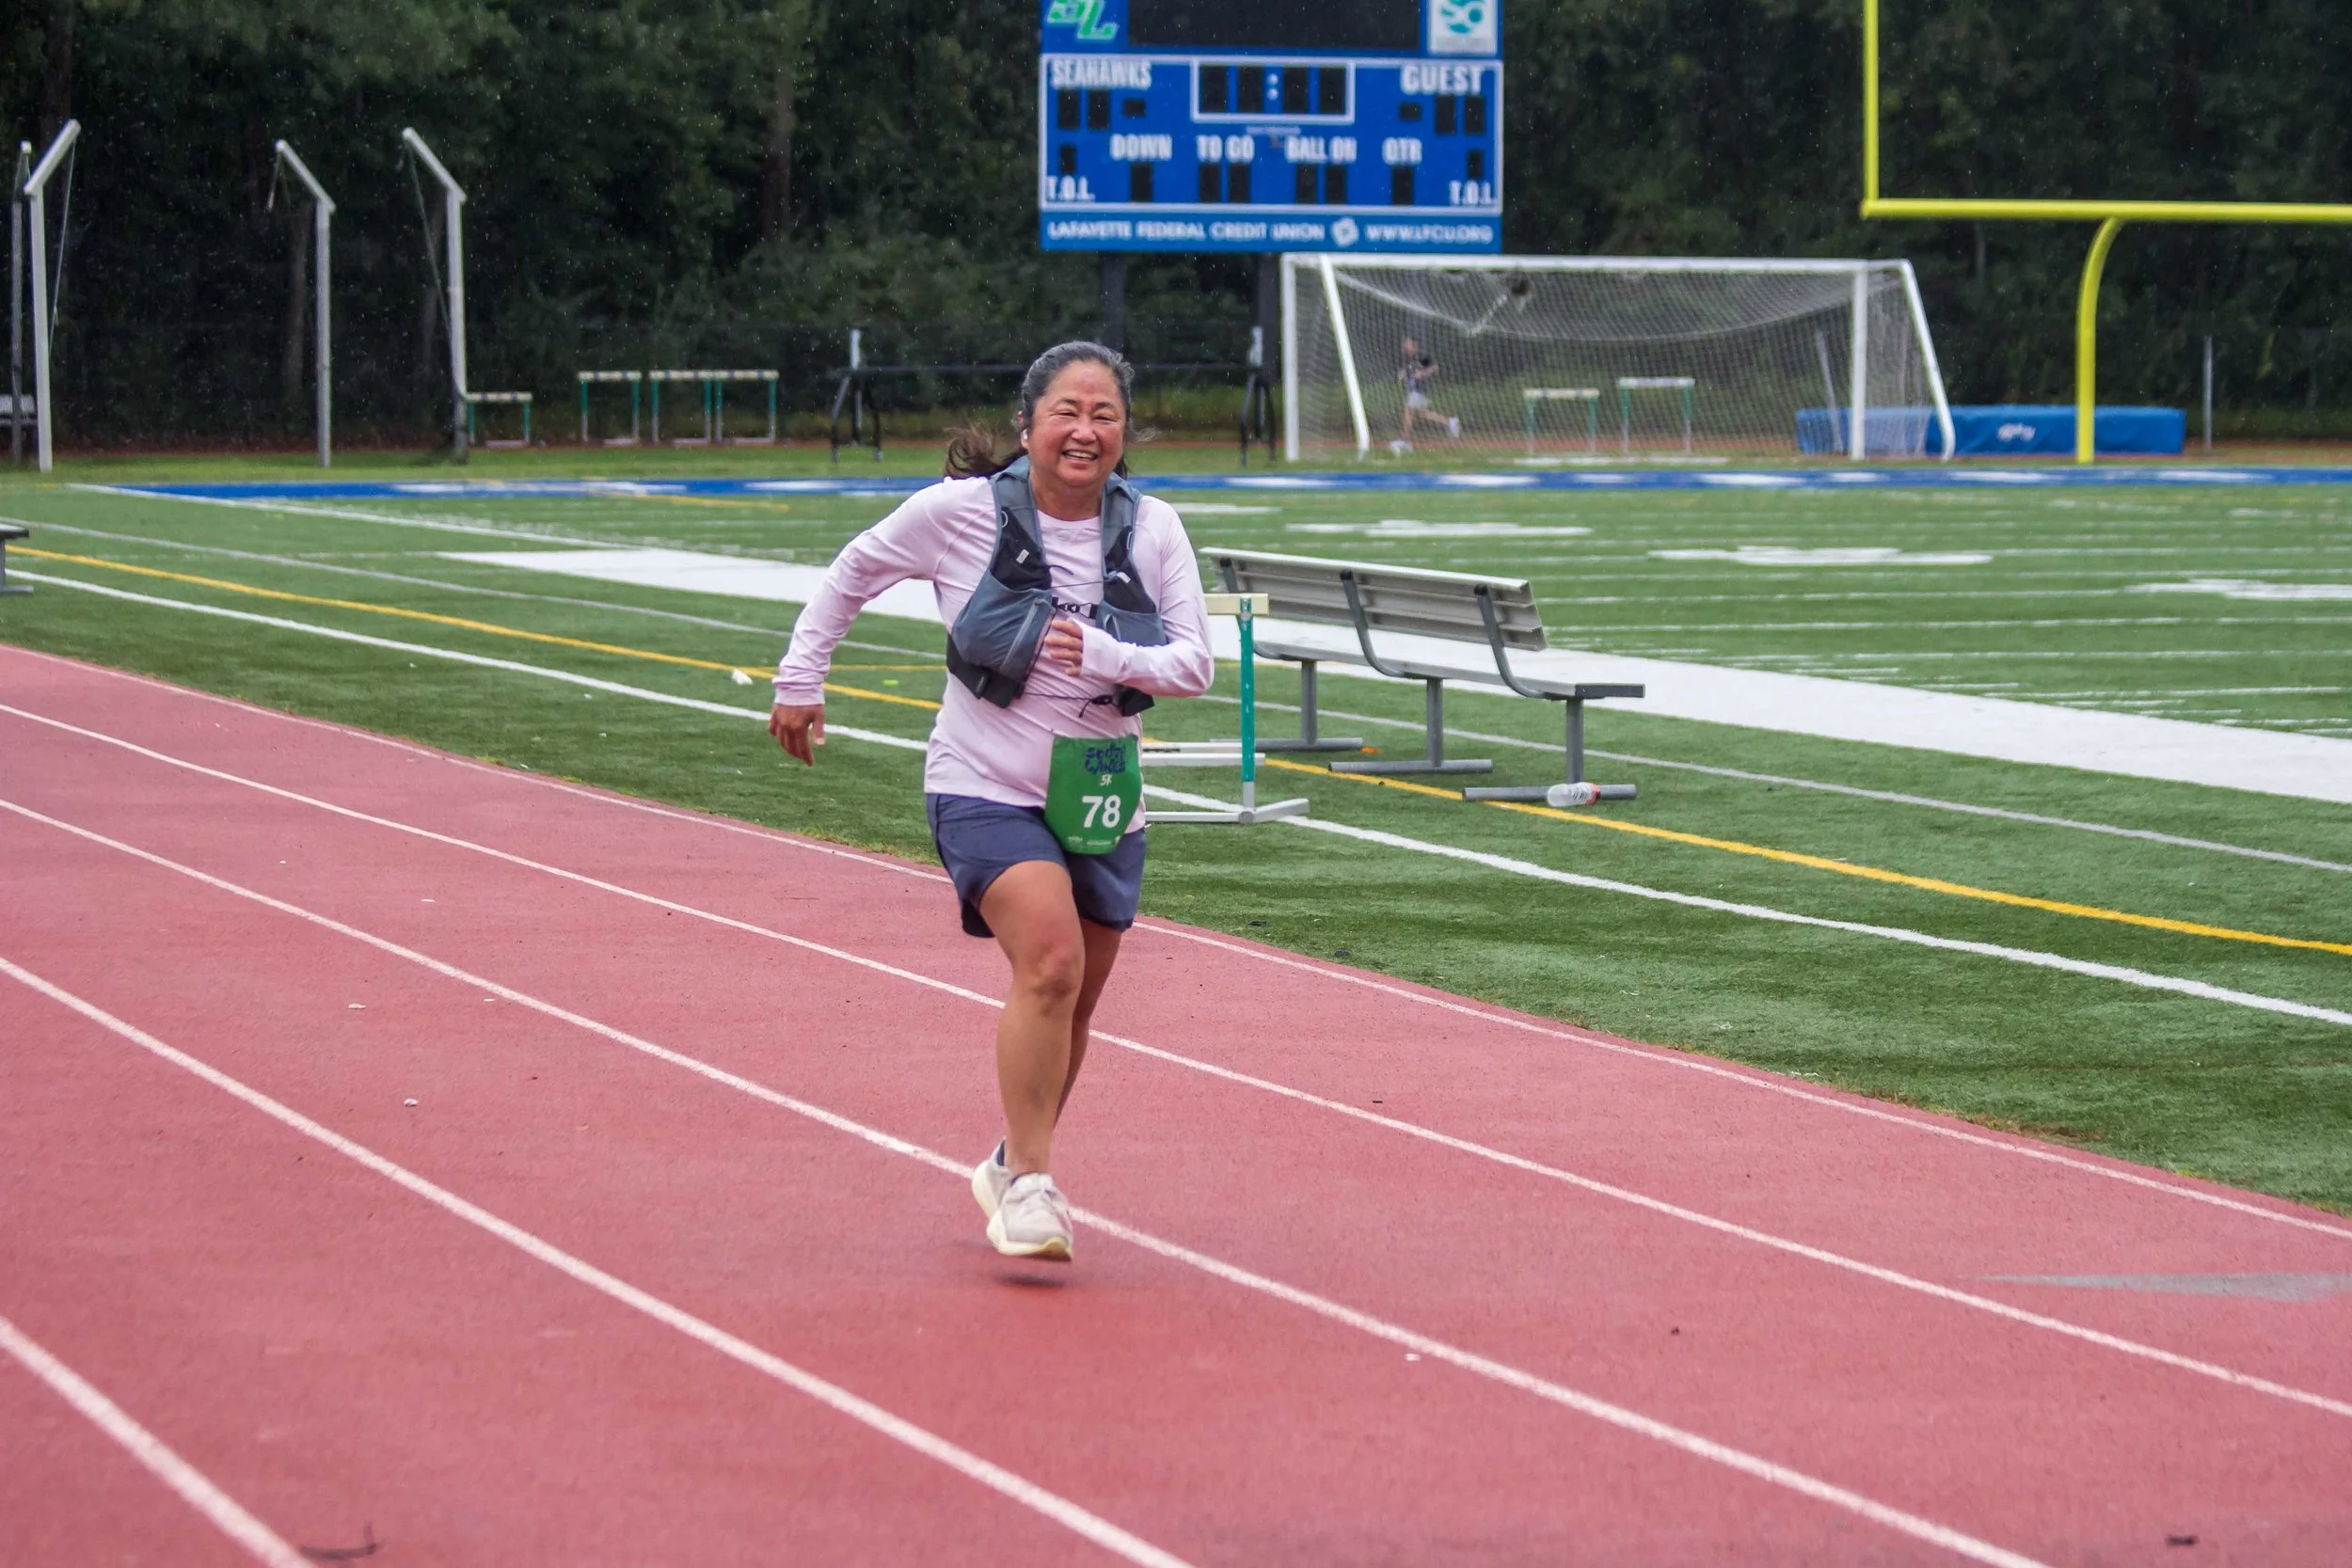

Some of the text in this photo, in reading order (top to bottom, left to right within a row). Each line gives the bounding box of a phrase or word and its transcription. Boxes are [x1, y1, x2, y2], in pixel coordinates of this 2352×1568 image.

[1051, 59, 1152, 89] SEAHAWKS
[1401, 64, 1482, 95] GUEST
[1109, 134, 1172, 160] DOWN
[1197, 135, 1254, 162] TO GO
[1285, 135, 1357, 163] BALL ON
[1382, 136, 1422, 165] QTR
[1047, 220, 1132, 240] LAFAYETTE
[1136, 221, 1206, 241] FEDERAL
[1209, 222, 1267, 242] CREDIT
[1271, 222, 1325, 242] UNION
[1082, 795, 1121, 828] 78
